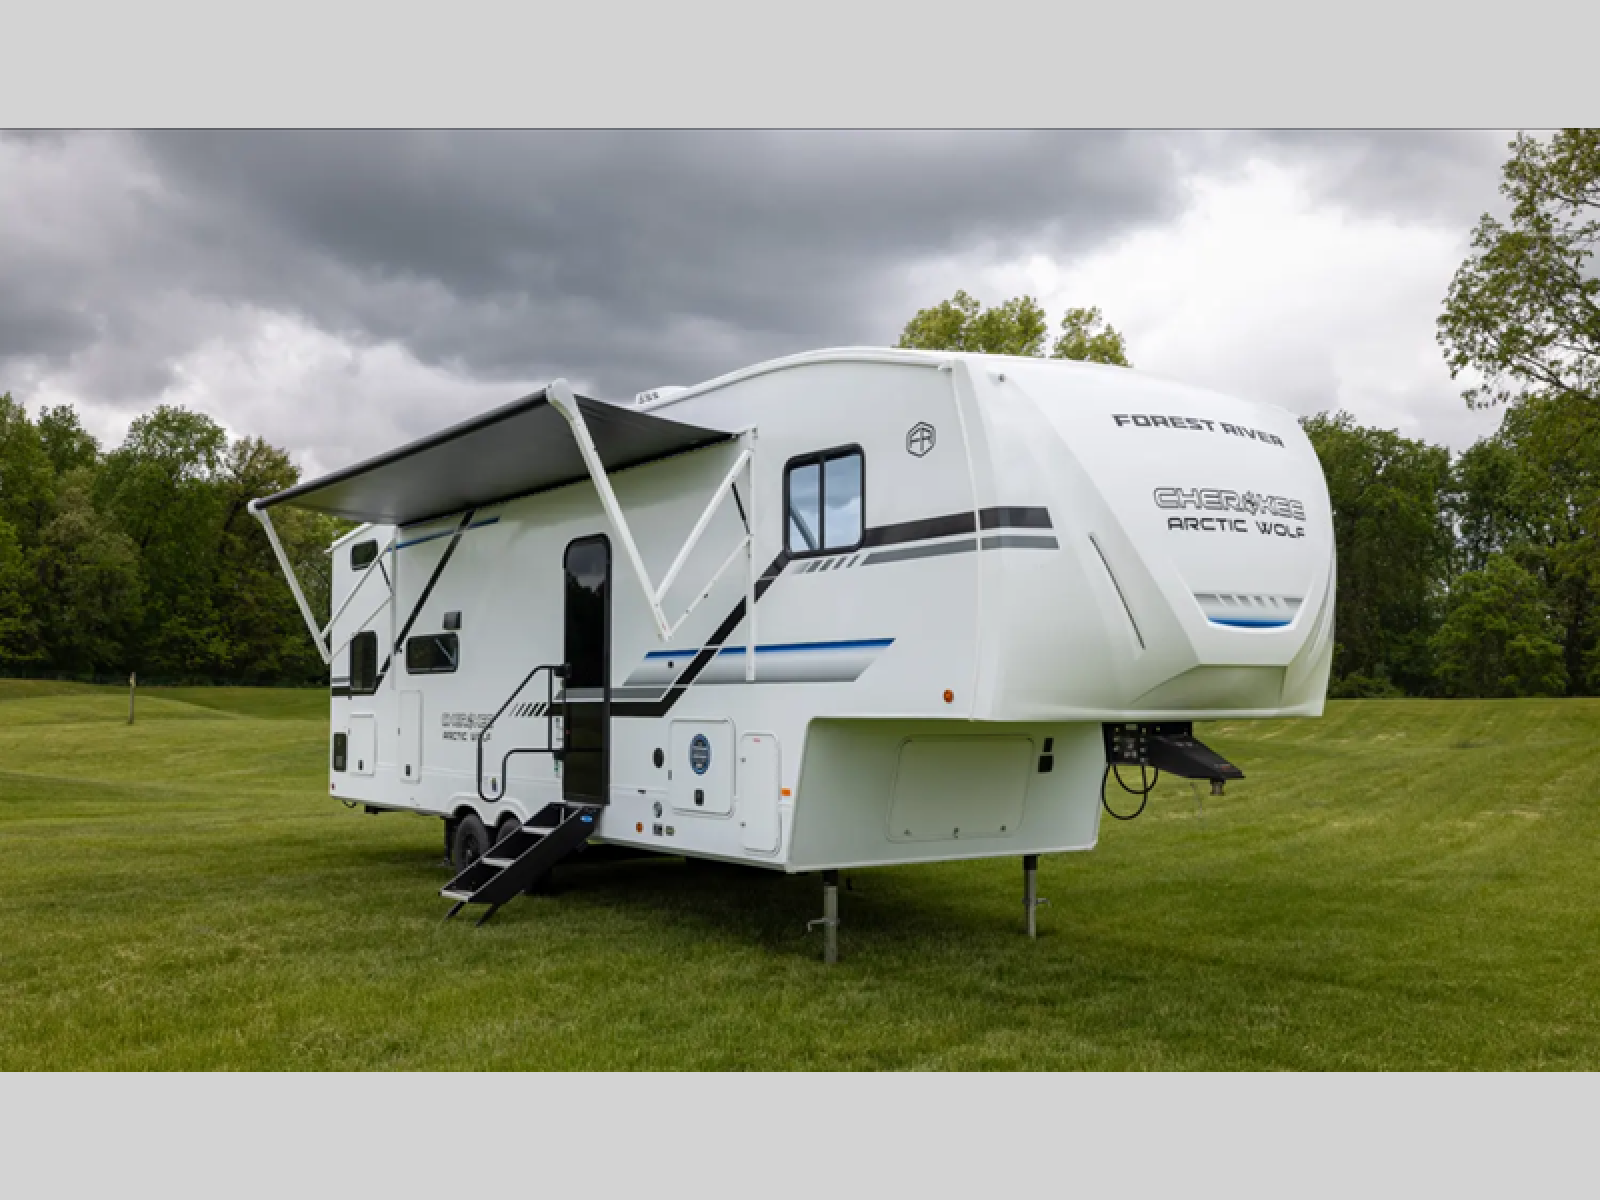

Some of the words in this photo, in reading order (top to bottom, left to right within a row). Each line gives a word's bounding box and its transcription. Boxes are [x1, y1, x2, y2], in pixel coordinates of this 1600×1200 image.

[1112, 413, 1215, 432] FOREST
[1219, 421, 1285, 448] RIVER
[1153, 486, 1306, 521] CHEROKEE
[1167, 517, 1249, 533] ARCTIC
[1255, 520, 1306, 538] WOLF
